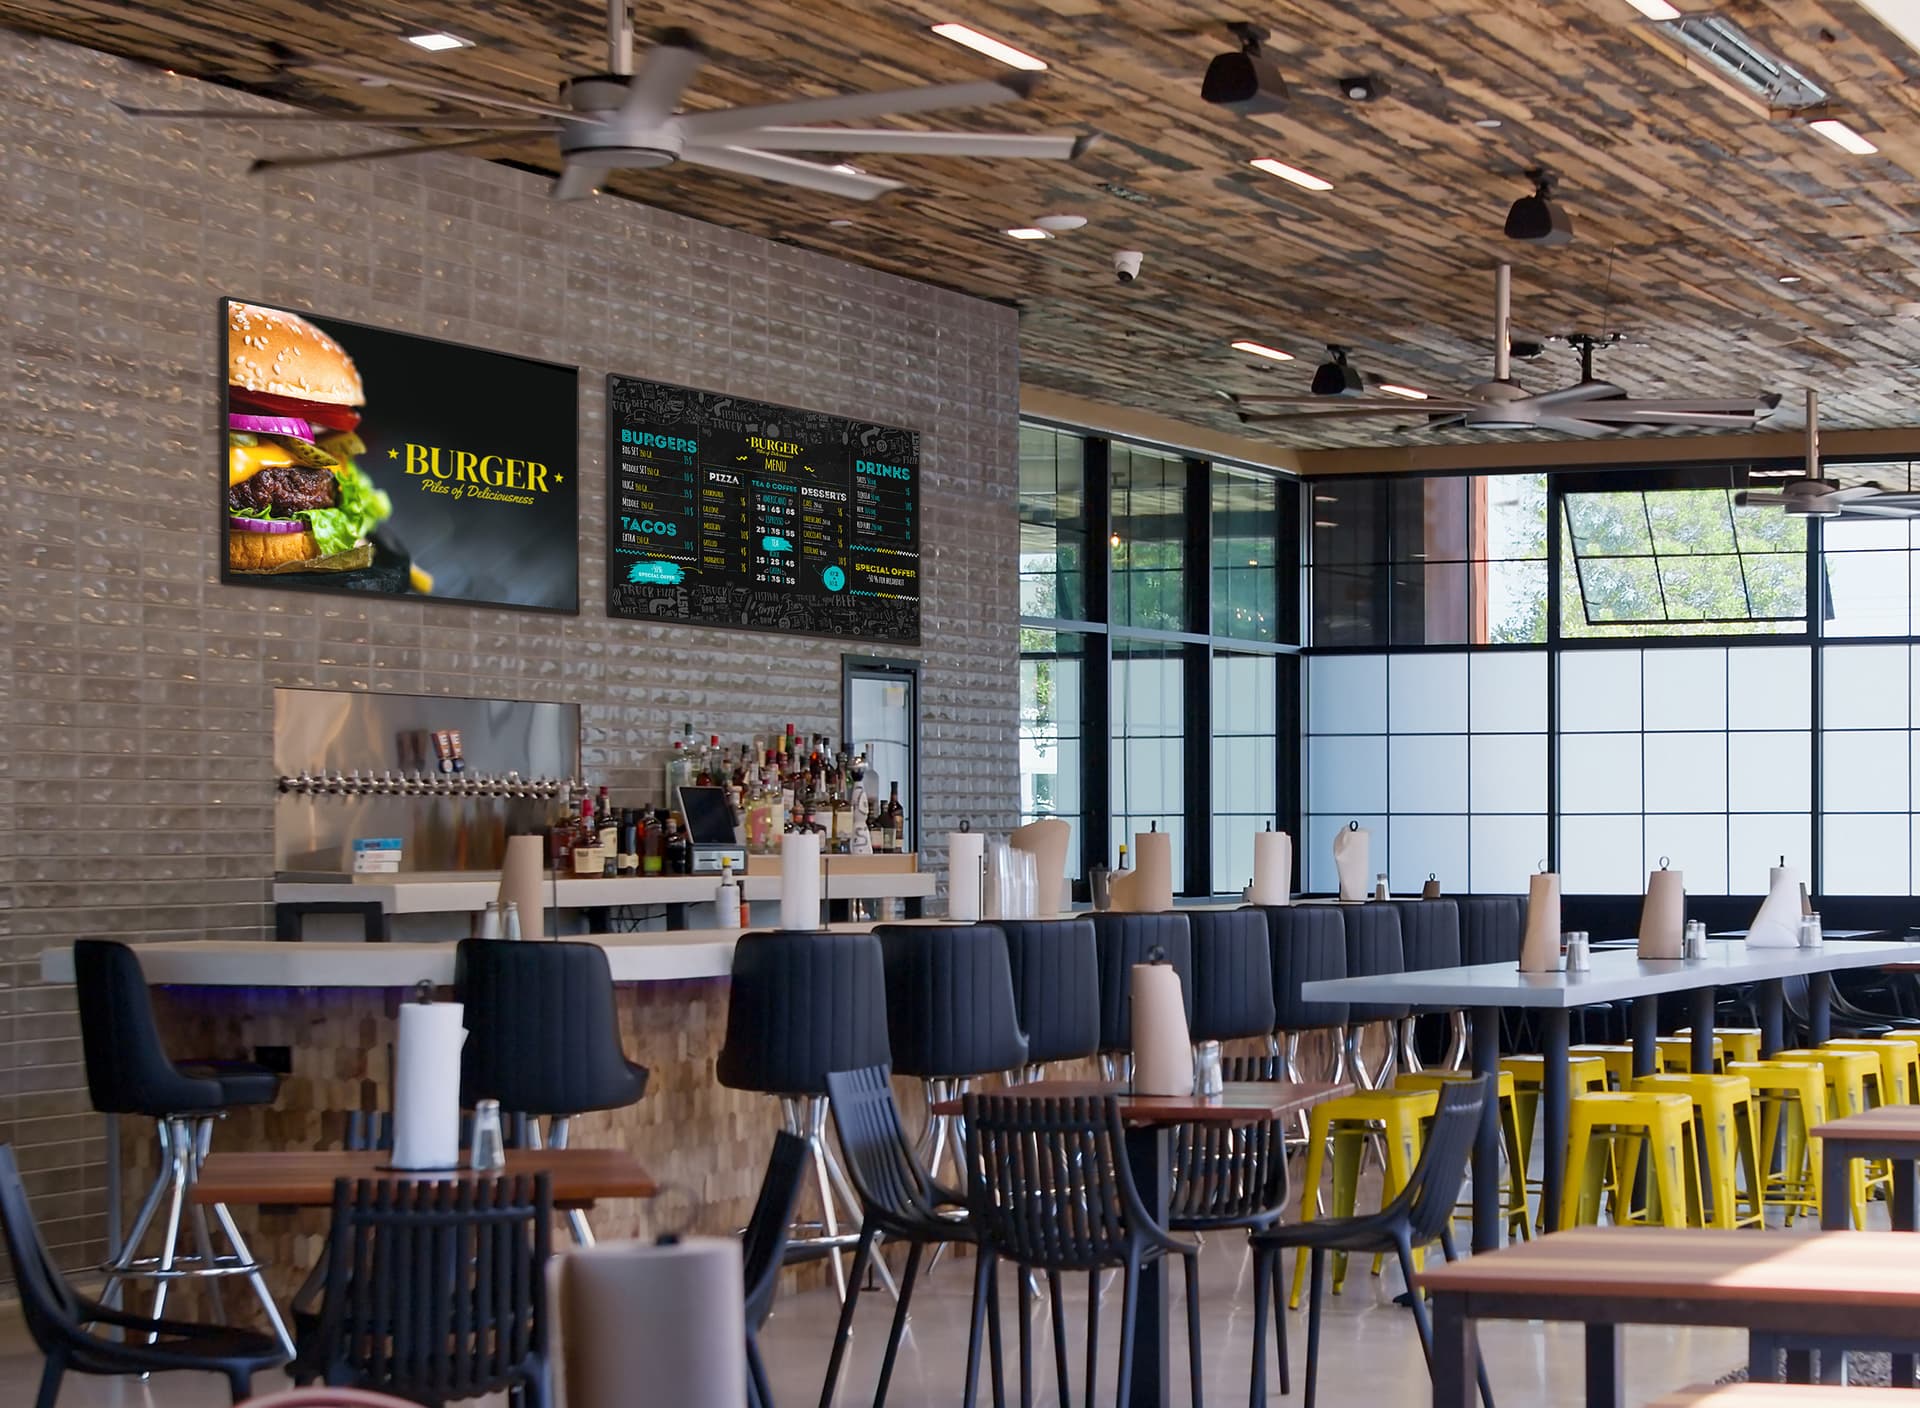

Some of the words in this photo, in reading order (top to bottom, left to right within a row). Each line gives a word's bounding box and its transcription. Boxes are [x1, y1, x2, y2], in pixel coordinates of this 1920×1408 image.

[621, 429, 697, 454] BURGERS
[751, 436, 799, 455] BURGER
[404, 442, 549, 493] BURGER
[764, 457, 787, 473] MENU
[856, 459, 911, 481] DRINKS
[709, 471, 740, 485] PIZZA
[752, 480, 765, 488] TEA
[772, 483, 798, 493] COFFEE
[421, 478, 450, 494] Piles
[451, 484, 465, 500] of
[467, 485, 535, 505] Deliciousness
[801, 486, 847, 502] DESSERTS
[620, 516, 678, 537] TACOS
[855, 563, 890, 575] SPECIAL
[891, 567, 916, 578] OFFER
